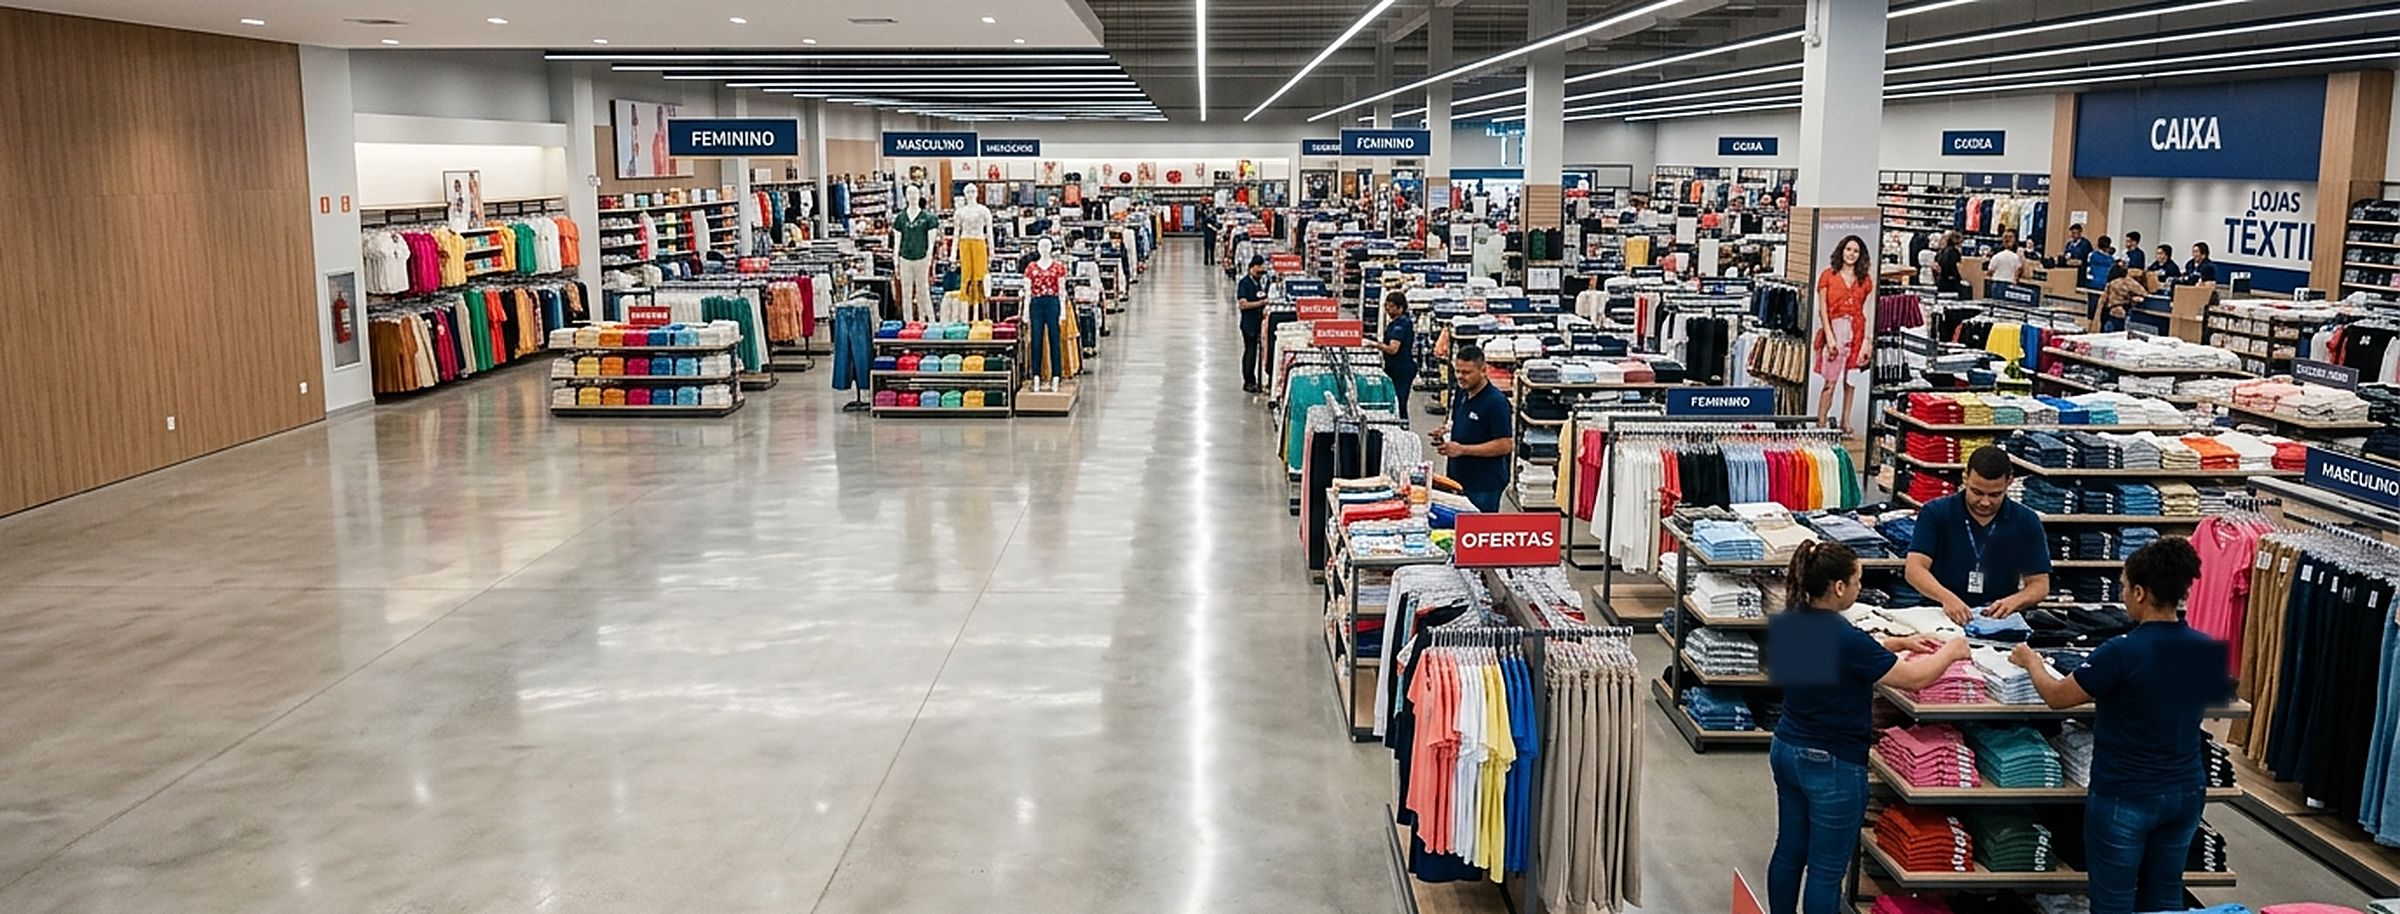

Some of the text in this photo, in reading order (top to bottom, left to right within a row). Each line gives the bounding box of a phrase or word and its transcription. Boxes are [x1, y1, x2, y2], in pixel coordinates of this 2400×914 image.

[691, 130, 775, 147] FEMININO
[2151, 116, 2222, 151] CAIXA
[2251, 190, 2301, 213] LOJAS
[1461, 531, 1555, 549] OFERTAS
